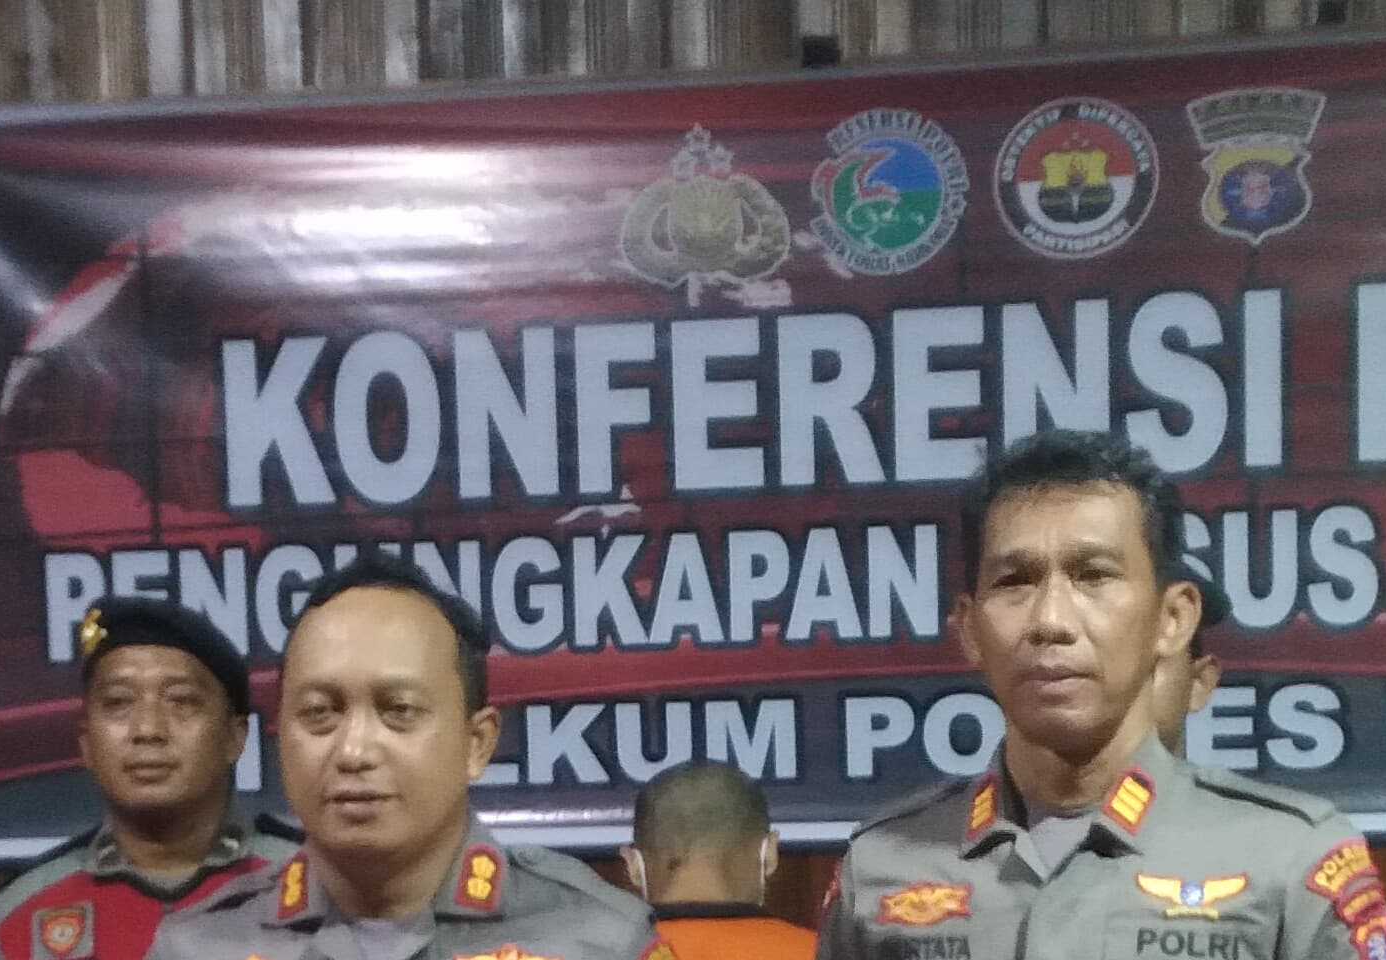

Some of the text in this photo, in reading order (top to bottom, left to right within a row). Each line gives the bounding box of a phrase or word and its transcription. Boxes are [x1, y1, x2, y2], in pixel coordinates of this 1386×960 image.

[221, 289, 1283, 508] KONFERENSI
[44, 523, 940, 664] PENGNGKAPAN
[845, 683, 1345, 778] POES
